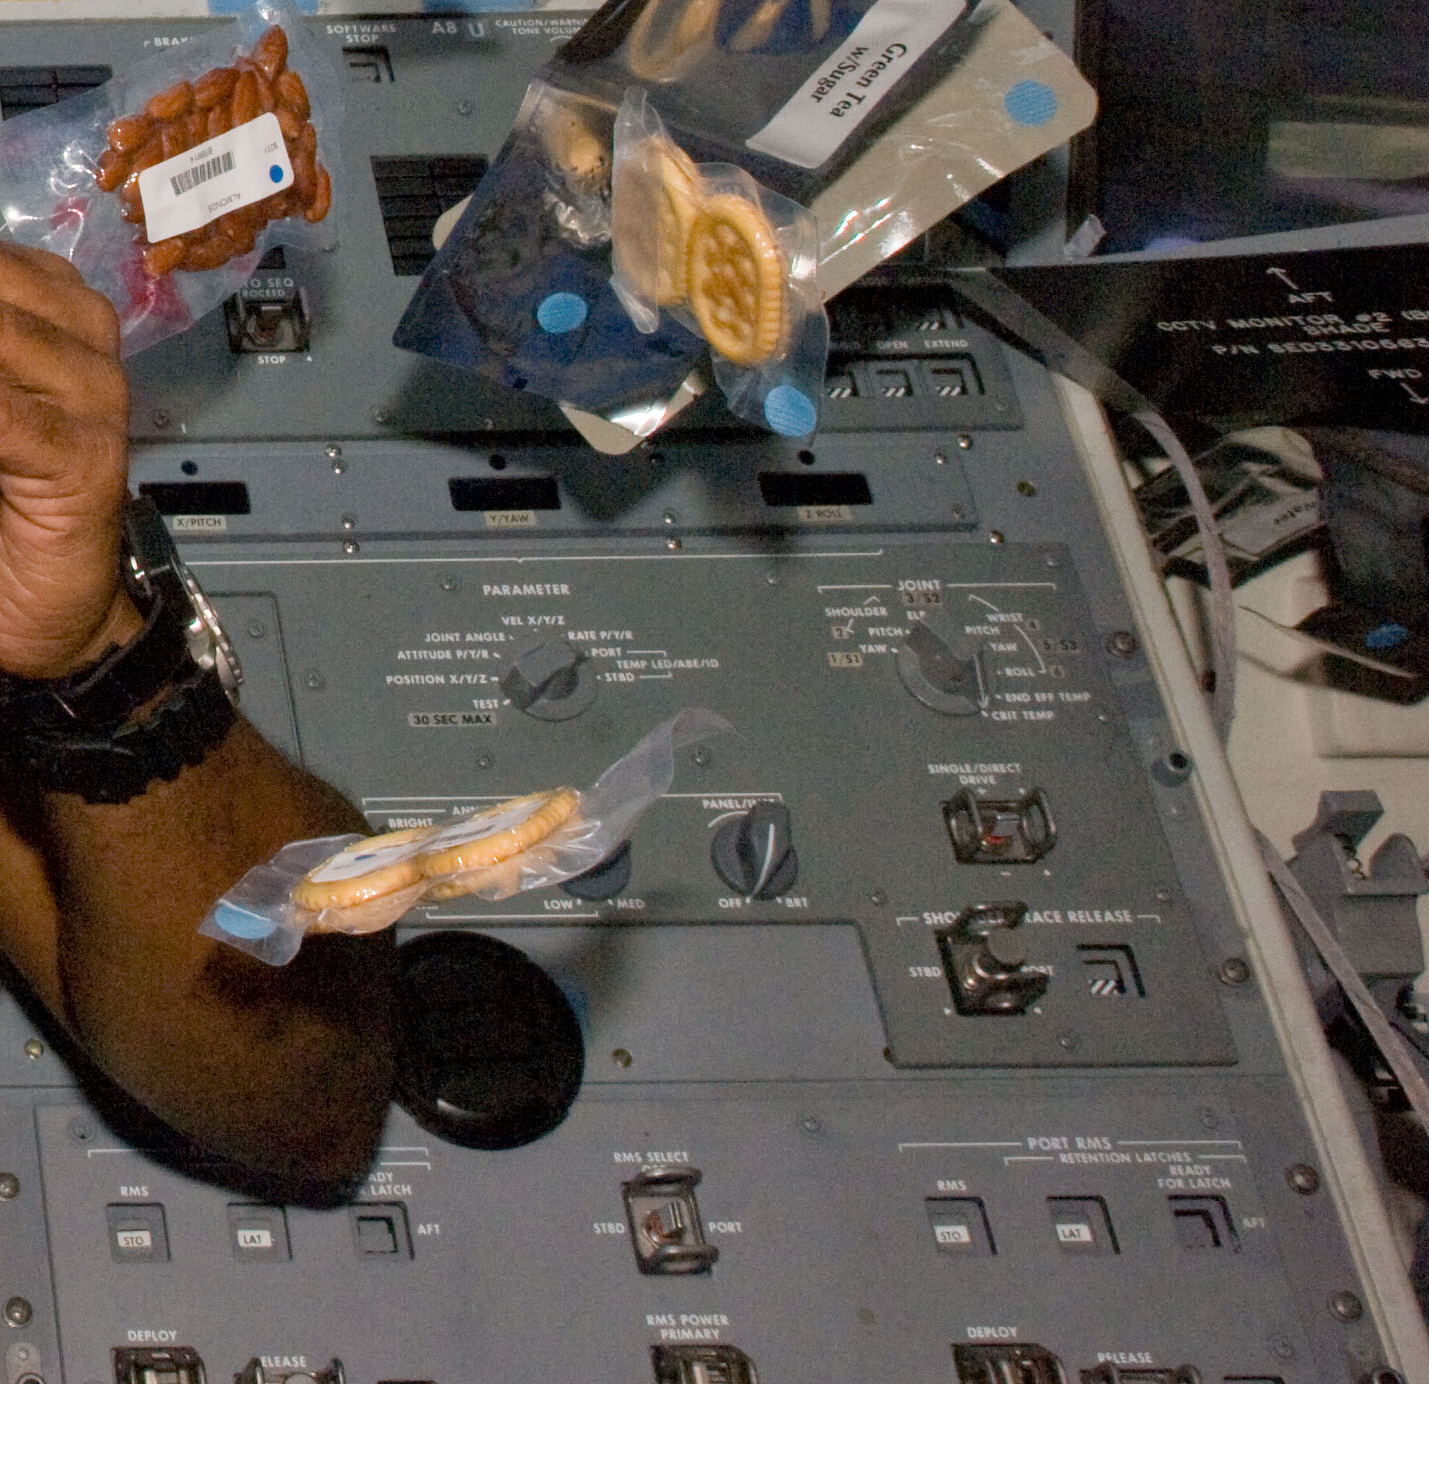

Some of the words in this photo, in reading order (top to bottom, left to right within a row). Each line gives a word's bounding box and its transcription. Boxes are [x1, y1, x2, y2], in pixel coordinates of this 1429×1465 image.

[327, 24, 398, 35] SOFTWARE
[432, 23, 458, 35] A8
[856, 43, 908, 87] Green
[811, 47, 869, 103] w/Sugar
[829, 92, 866, 117] Tea
[207, 192, 241, 214] ALMONDS
[1286, 291, 1335, 304] AFT
[1156, 320, 1217, 332] CCTV
[1226, 314, 1346, 330] MONITOR
[1303, 323, 1390, 336] SHADE
[924, 338, 969, 349] EXTEND
[1211, 345, 1260, 355] P/N
[1368, 368, 1423, 379] FWD
[482, 584, 571, 597] PARAMETER
[897, 579, 942, 591] JOINT
[825, 606, 888, 618] SHOULDER
[502, 616, 524, 626] VEL
[528, 615, 566, 626] X/Y/Z
[425, 632, 462, 643] JOINT
[465, 631, 506, 642] ANGLE
[567, 630, 597, 641] RATE
[868, 626, 904, 638] PITCH
[397, 650, 453, 661] ATTITUDE
[616, 659, 647, 669] TEMP
[386, 674, 446, 685] POSITION
[449, 674, 488, 686] X/Y/Z
[1034, 691, 1056, 703] EFF
[433, 714, 459, 725] SEC
[461, 714, 493, 726] MAX
[928, 763, 1022, 775] SINGLE/DIRECT
[1067, 910, 1133, 924] RELEASE
[1027, 1136, 1069, 1151] PORT
[1075, 1136, 1112, 1151] RMS
[613, 1151, 643, 1163] RMS
[646, 1151, 689, 1163] SELECT
[1060, 1151, 1132, 1164] RETENTION
[1137, 1151, 1192, 1165] LATCHES
[1169, 1165, 1212, 1177] READY
[1157, 1177, 1181, 1189] FOR
[1184, 1177, 1231, 1190] LATCH
[370, 1184, 412, 1196] LATCH
[1242, 1216, 1266, 1229] AFT
[646, 1313, 677, 1326] RMS
[680, 1313, 729, 1327] POWER
[127, 1329, 177, 1341] DEPLOY
[660, 1327, 721, 1341] PRIMARY
[967, 1325, 1017, 1338] DEPLOY
